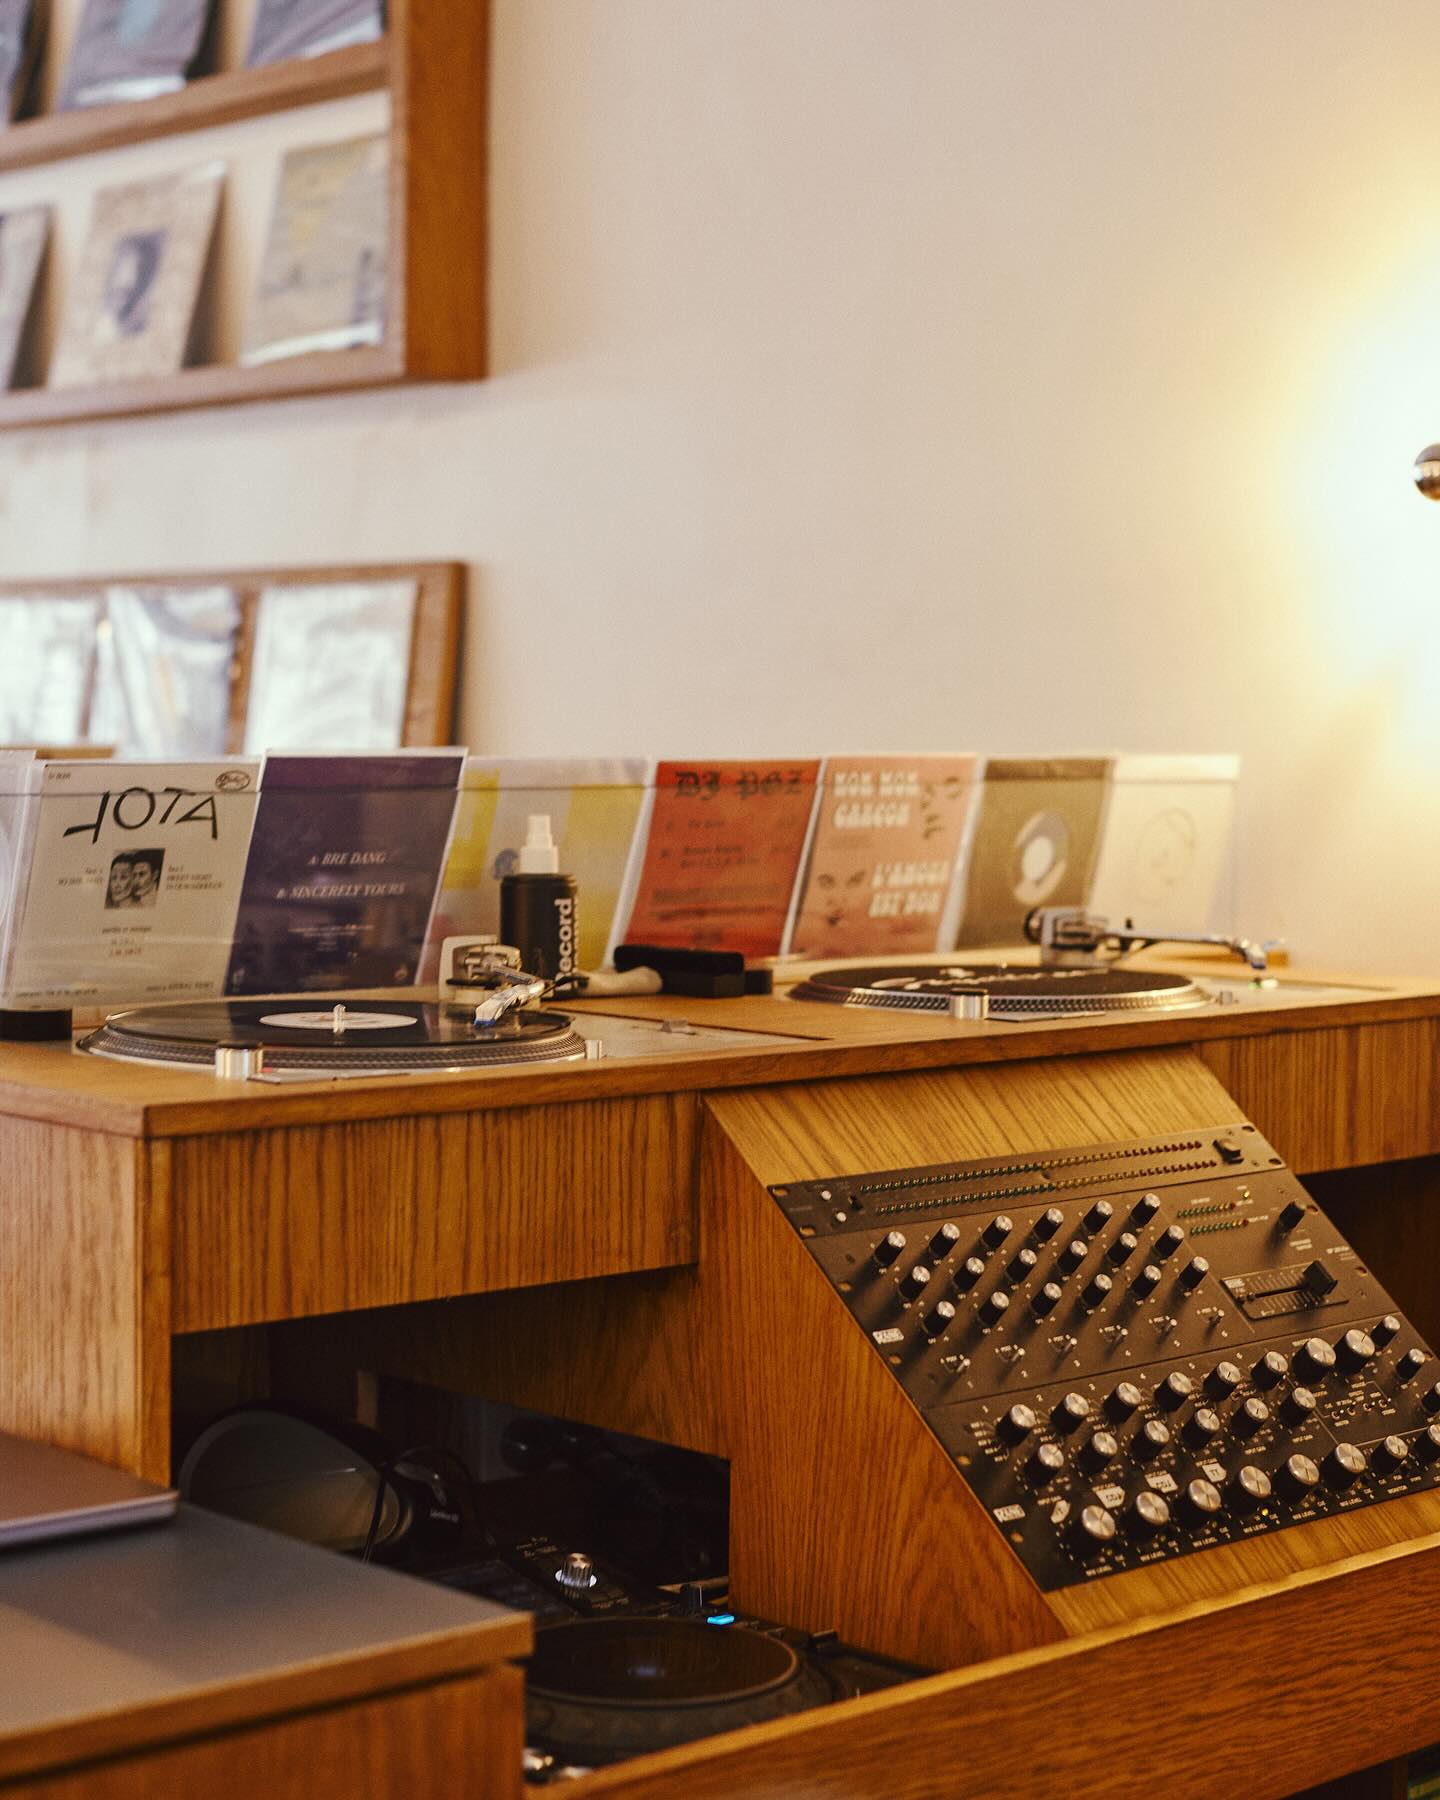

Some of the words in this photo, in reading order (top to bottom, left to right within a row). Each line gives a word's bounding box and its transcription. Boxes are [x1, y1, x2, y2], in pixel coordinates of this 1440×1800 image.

[63, 786, 218, 844] JOTA
[350, 851, 387, 865] DANG
[289, 883, 363, 899] SINCERELY
[364, 882, 407, 897] YOURS
